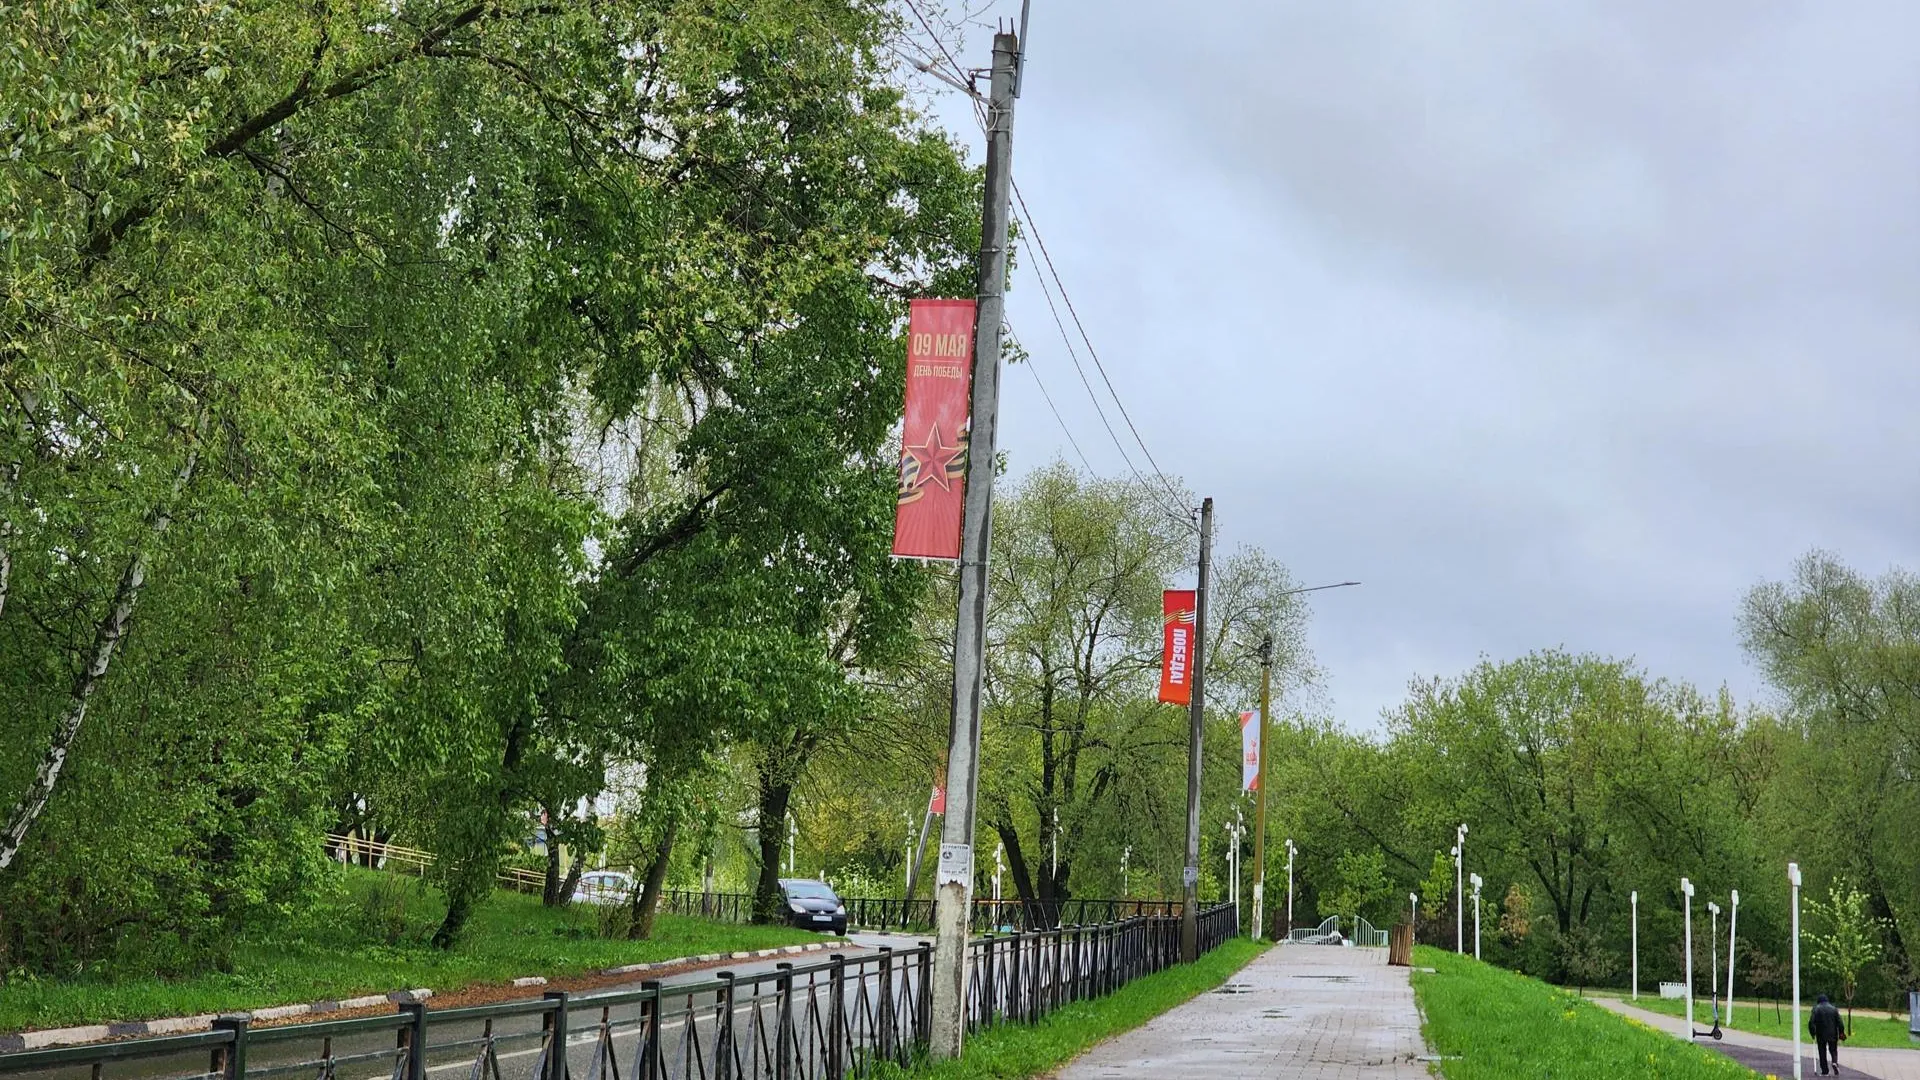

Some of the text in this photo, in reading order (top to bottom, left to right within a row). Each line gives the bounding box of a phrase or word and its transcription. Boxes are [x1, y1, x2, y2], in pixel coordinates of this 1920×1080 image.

[913, 333, 966, 358] 09 МАЯ
[913, 365, 963, 379] ДЕНЬ ПОБЕДЫ
[1170, 628, 1187, 685] ПОБЕДА!
